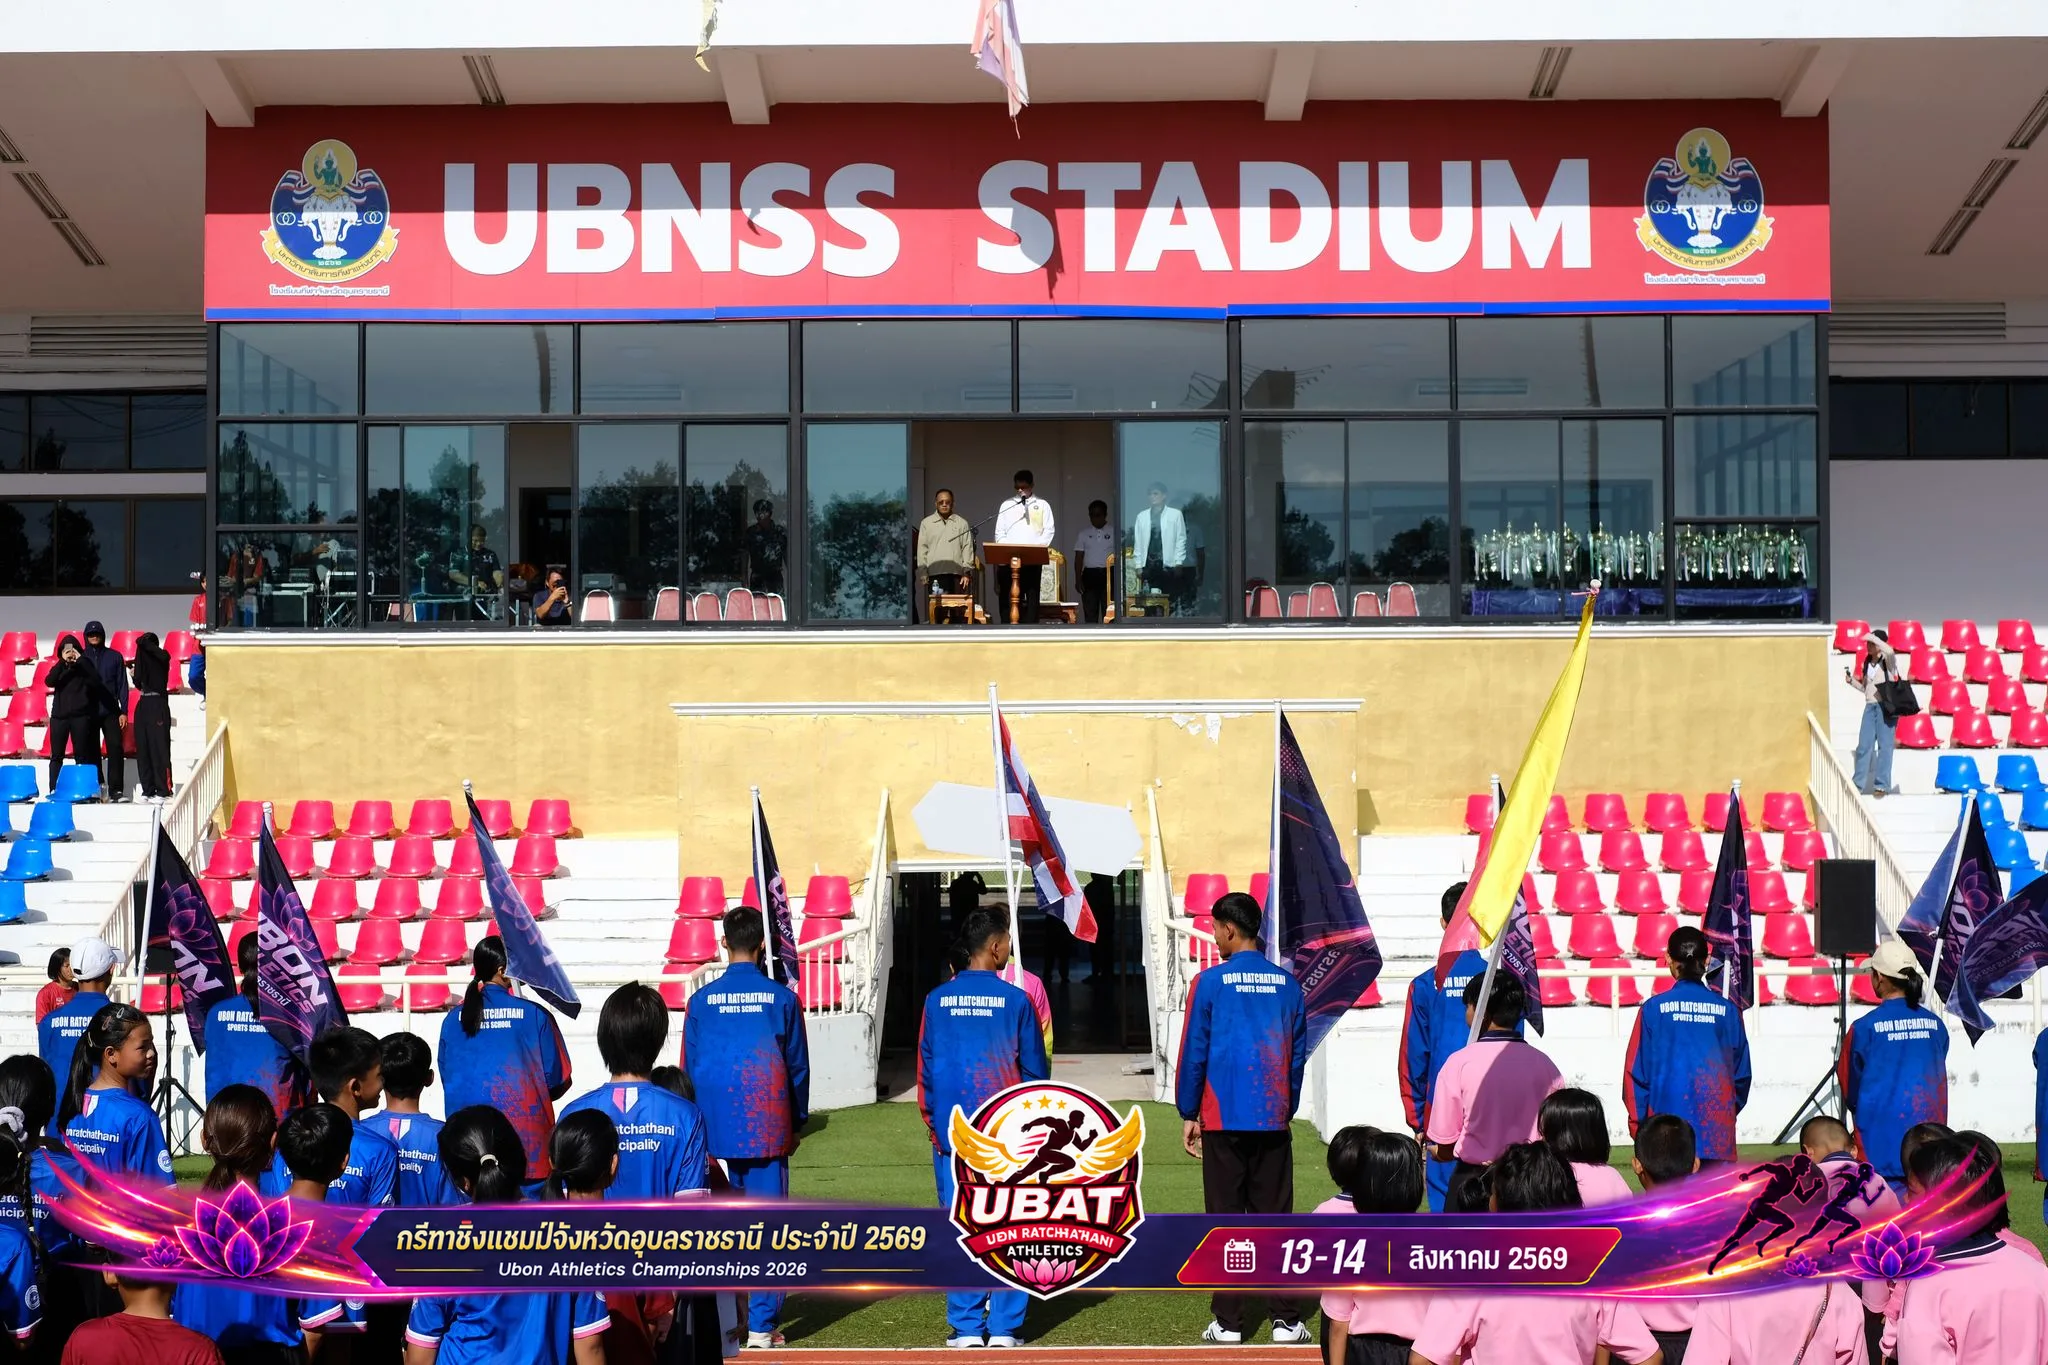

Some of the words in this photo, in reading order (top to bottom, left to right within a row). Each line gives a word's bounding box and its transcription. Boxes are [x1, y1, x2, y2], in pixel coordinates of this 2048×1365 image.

[444, 163, 901, 278] UBNSS
[977, 159, 1592, 274] STADIUM
[1222, 972, 1242, 984] UBON
[707, 993, 725, 1005] UBON
[1446, 989, 1464, 997] SPORT
[940, 996, 958, 1007] UBON
[959, 996, 1005, 1008] RATCHATHANI
[972, 1009, 993, 1017] SCHOOL
[51, 1017, 69, 1028] UBON
[227, 1023, 248, 1032] SPORTS
[249, 1025, 269, 1033] SCHO
[61, 1029, 82, 1037] SPORTS
[616, 1123, 675, 1136] tchathani
[618, 1138, 660, 1153] cipality
